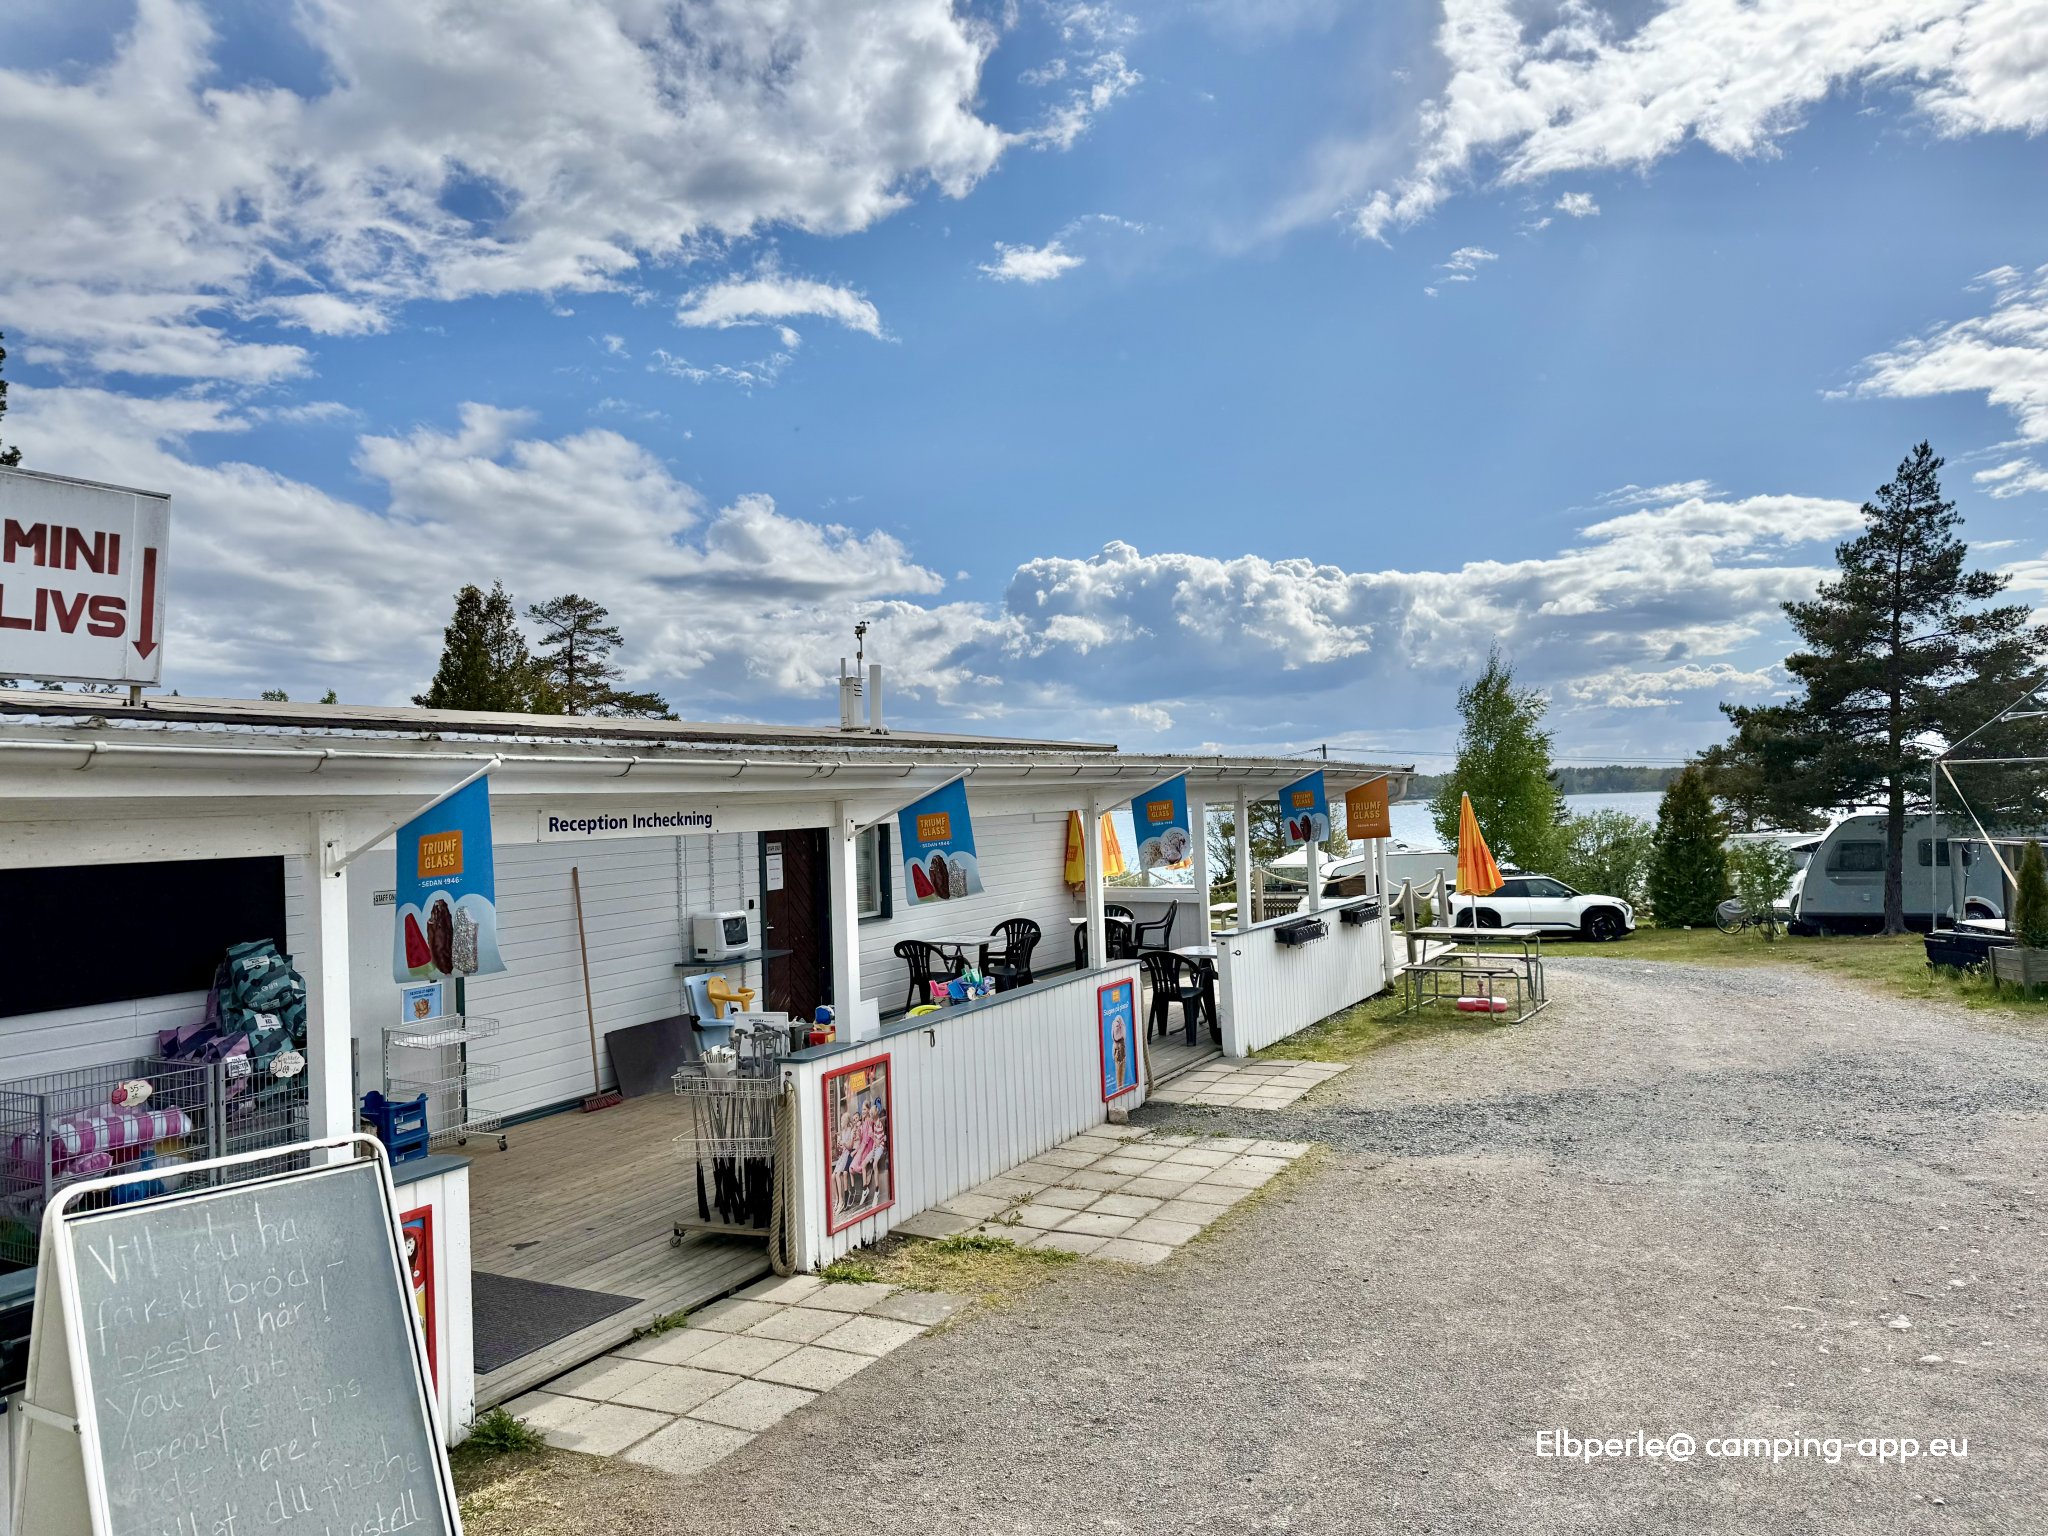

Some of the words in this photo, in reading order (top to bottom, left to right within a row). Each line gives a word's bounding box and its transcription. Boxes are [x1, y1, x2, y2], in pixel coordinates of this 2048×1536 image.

[3, 518, 121, 576] MINI
[0, 583, 127, 638] LIVS
[1351, 800, 1382, 811] TRIUMF
[1353, 810, 1380, 820] GLASS
[549, 814, 628, 835] Reception
[632, 810, 712, 828] Incheckning
[920, 816, 946, 828] TRIUMF
[922, 826, 946, 837] GLASS
[423, 838, 457, 856] TRIUMF
[425, 853, 455, 869] GLASS
[375, 894, 388, 903] STAFF
[88, 1226, 159, 1285] Vill
[254, 1200, 300, 1251] ha
[224, 1249, 310, 1304] bröd
[105, 1385, 184, 1450] You
[265, 1480, 314, 1525] du
